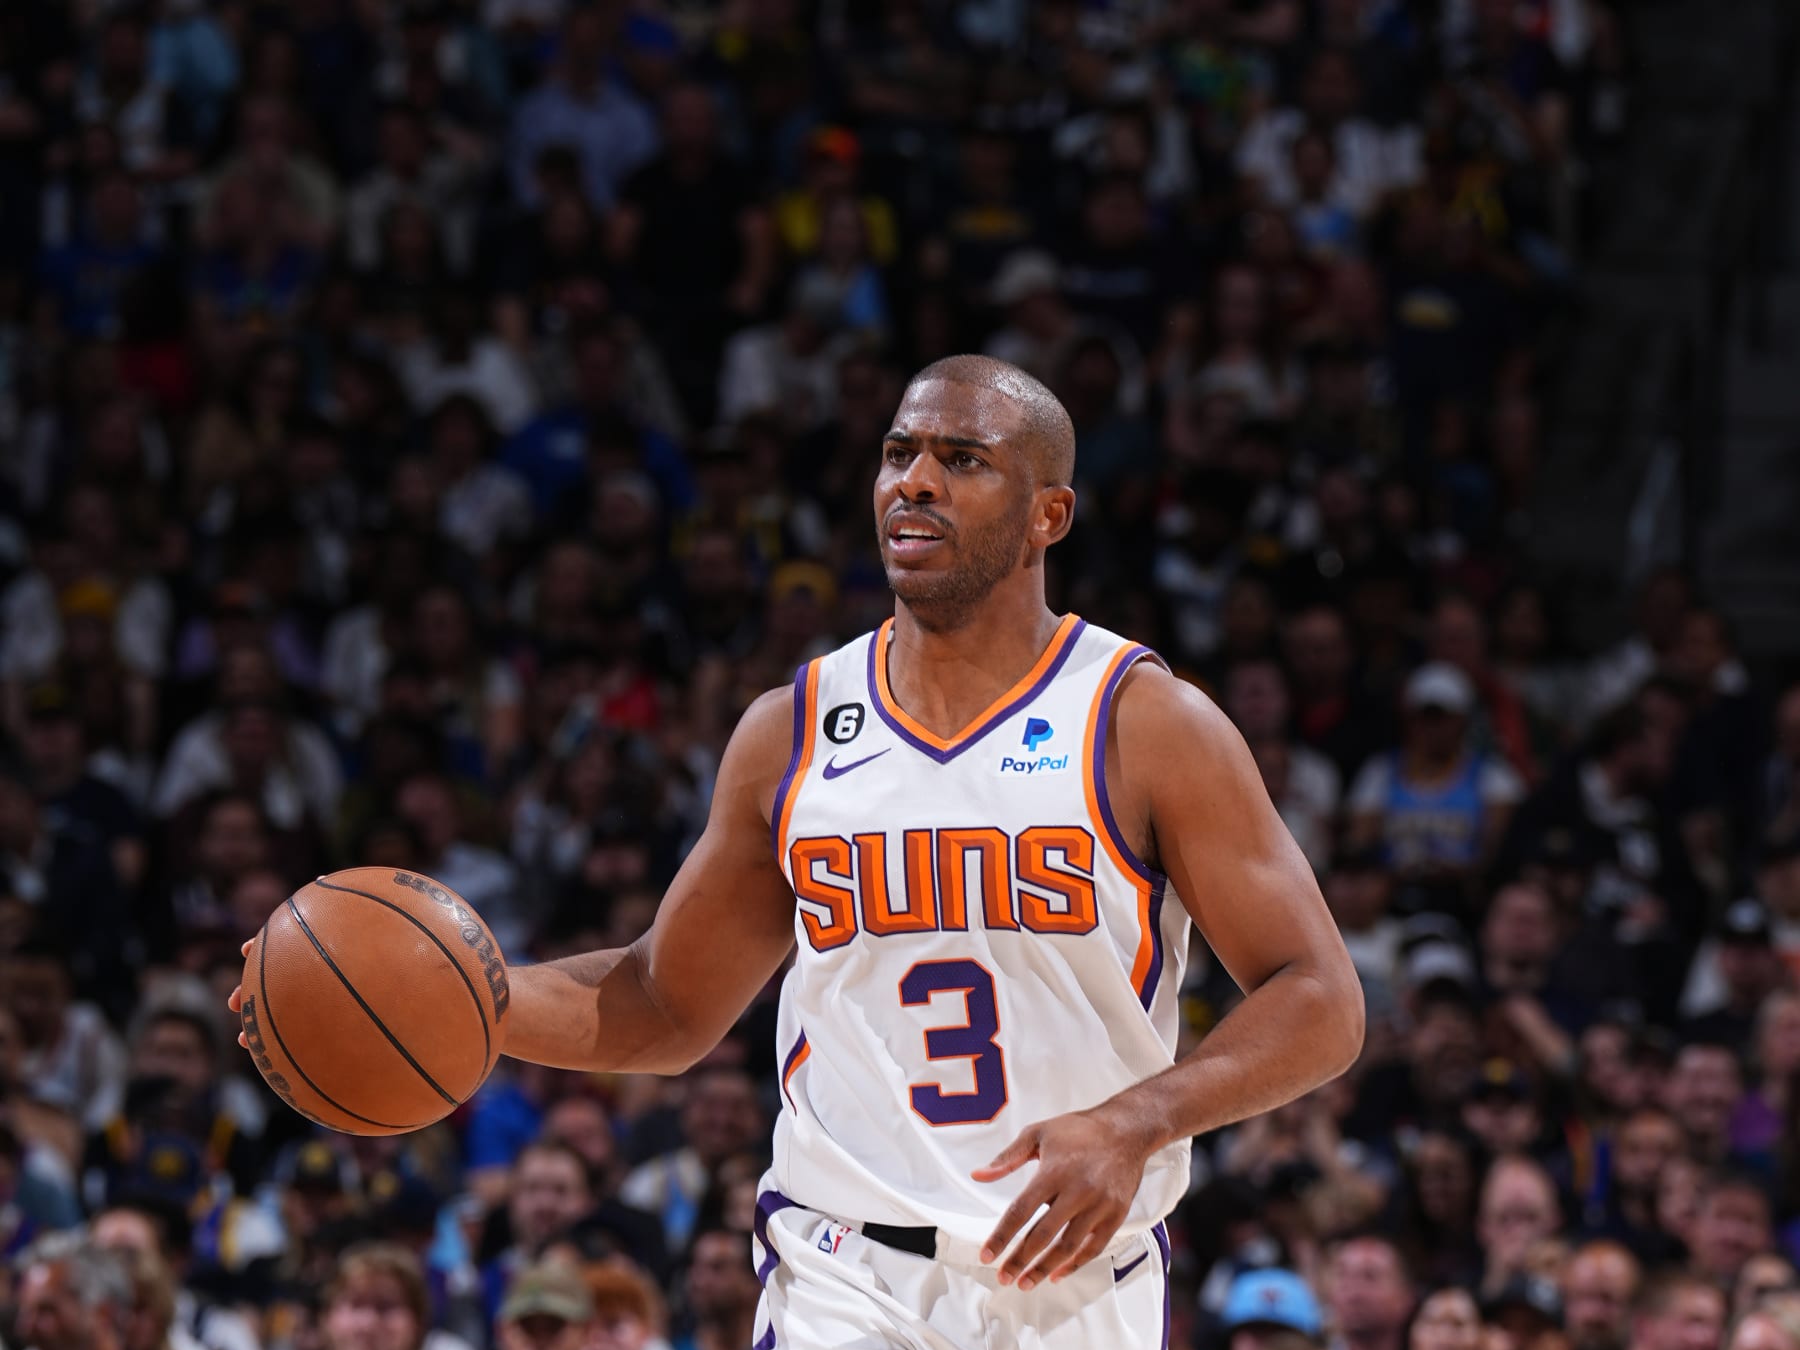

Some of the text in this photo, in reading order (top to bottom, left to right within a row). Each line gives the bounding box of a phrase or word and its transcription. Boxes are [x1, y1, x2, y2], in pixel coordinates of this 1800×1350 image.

[834, 707, 860, 741] 6
[1000, 754, 1068, 774] PayPal
[789, 826, 1100, 953] SUNS
[898, 957, 1009, 1128] 3
